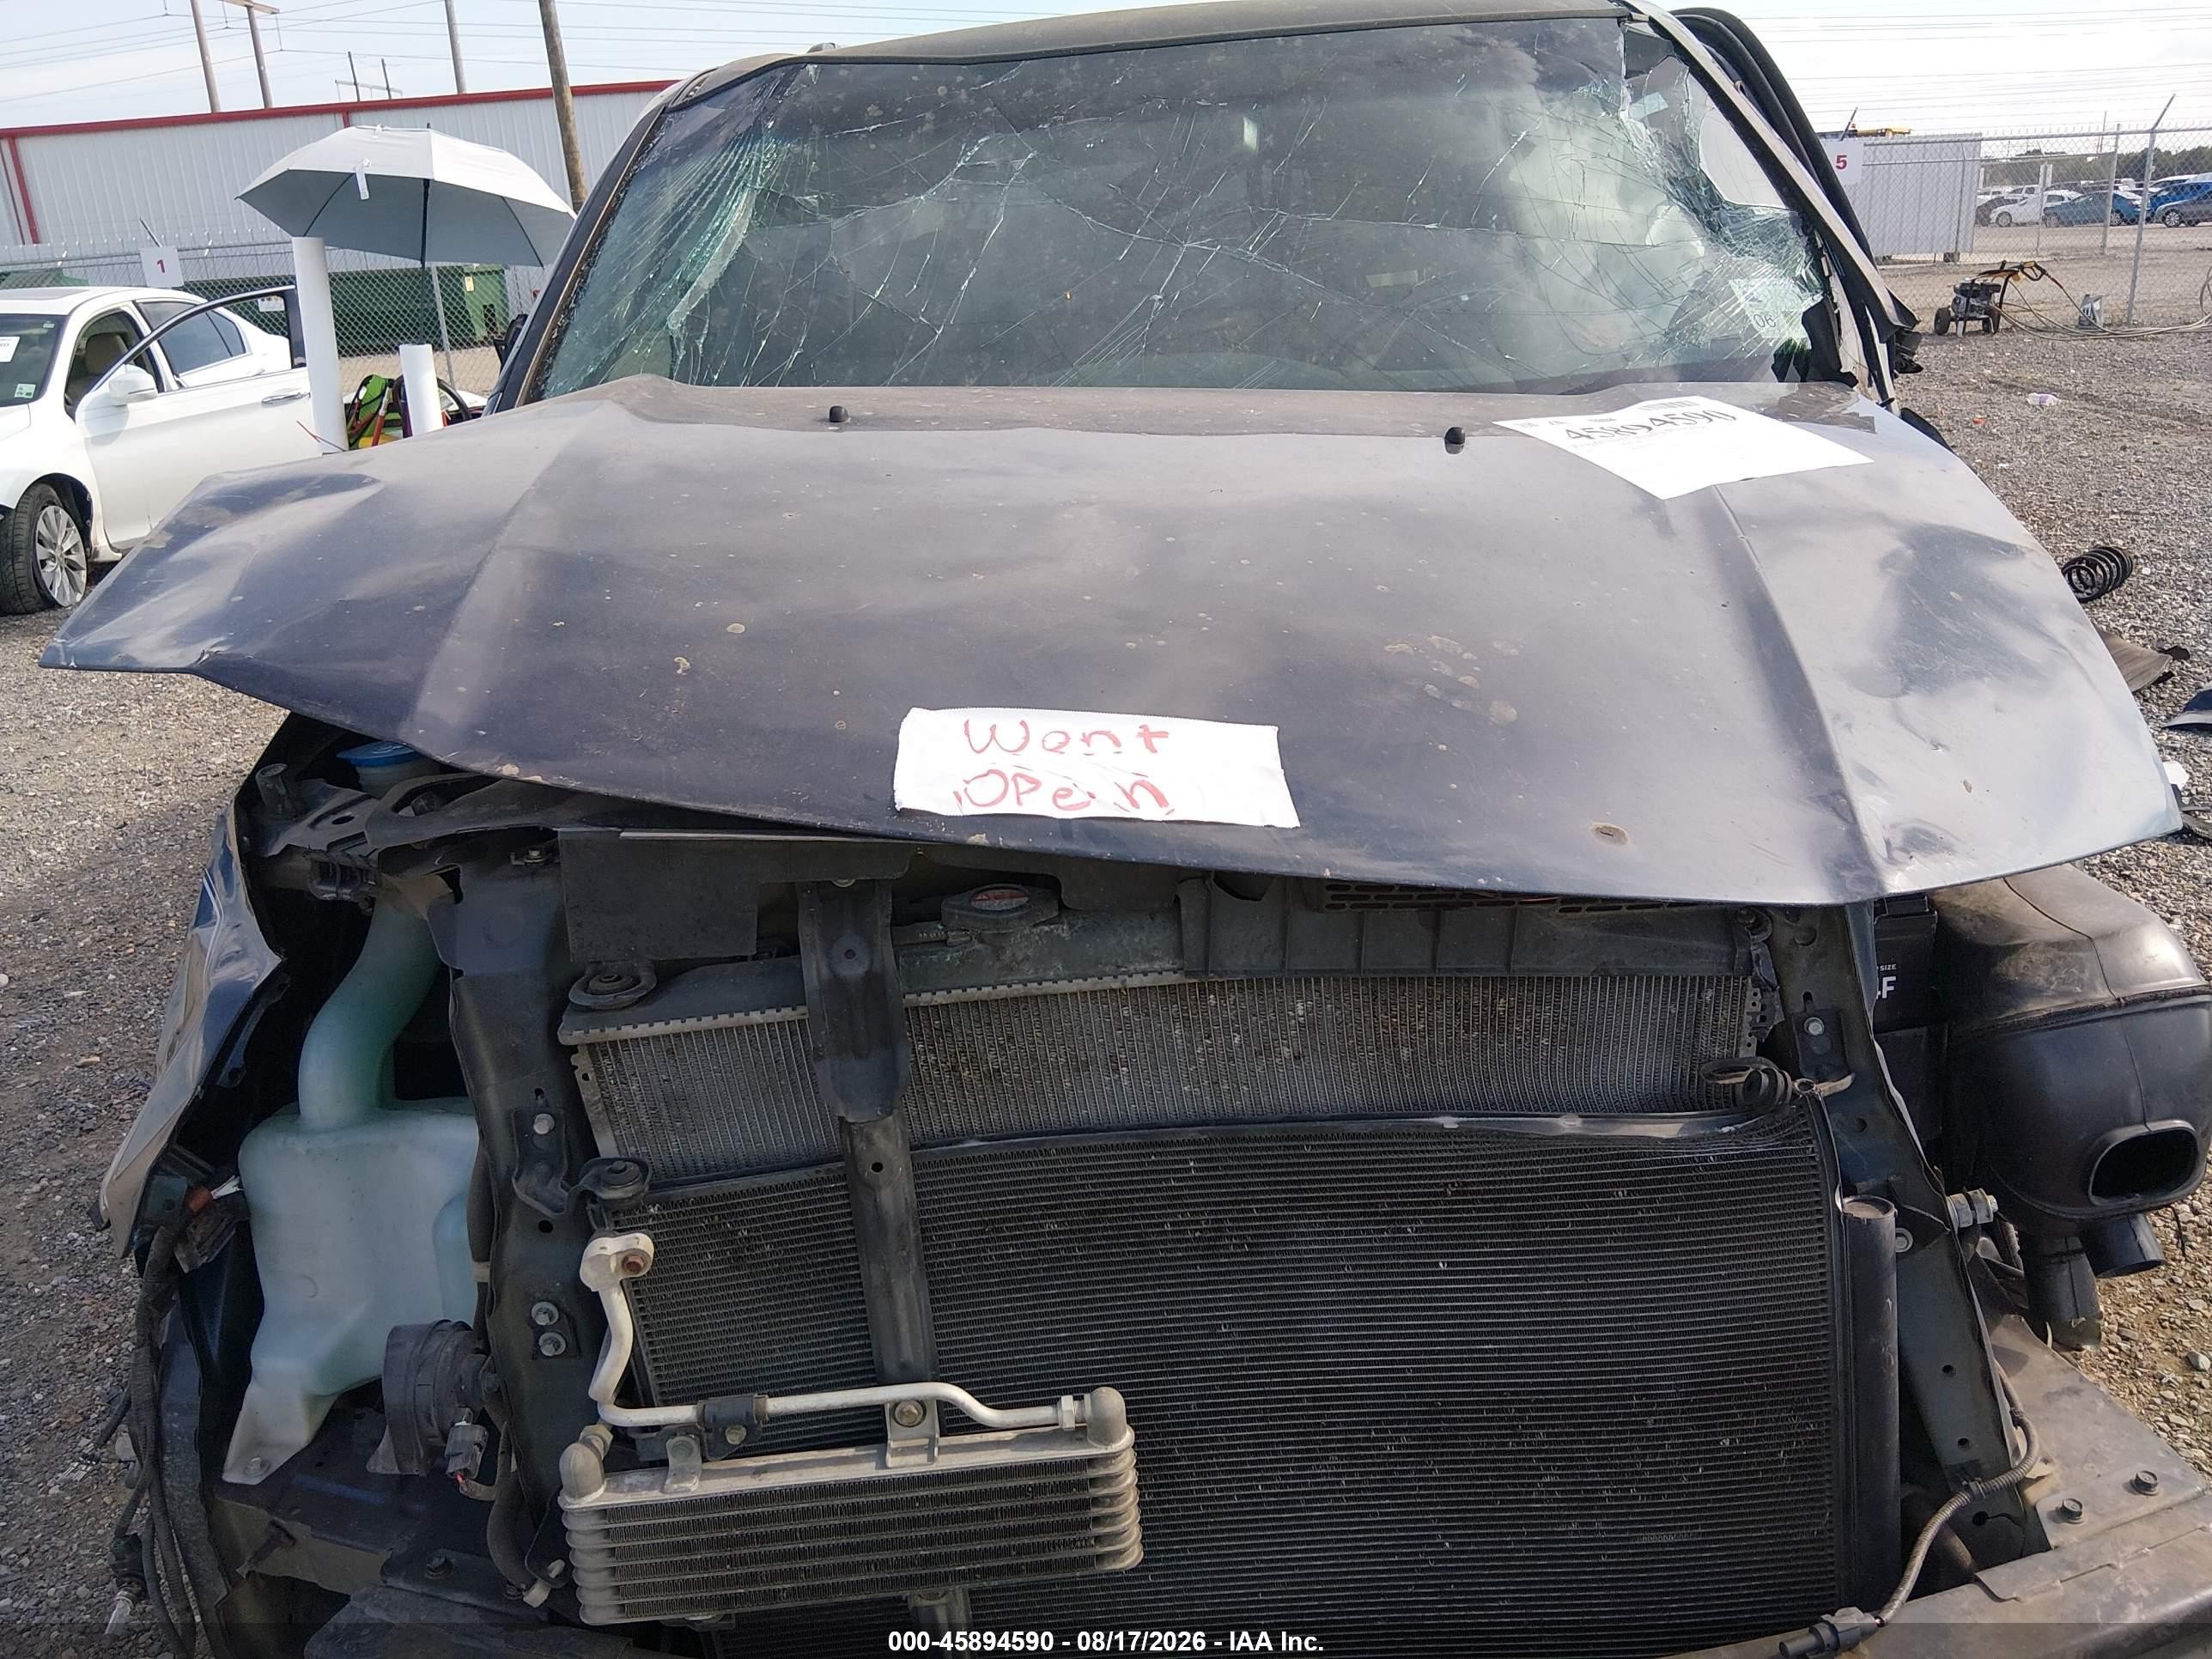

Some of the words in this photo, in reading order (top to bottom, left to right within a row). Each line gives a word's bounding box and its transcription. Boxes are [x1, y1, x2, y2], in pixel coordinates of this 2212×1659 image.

[1835, 155, 1848, 170] 5
[156, 258, 167, 274] 1
[1565, 409, 1737, 441] 45894590
